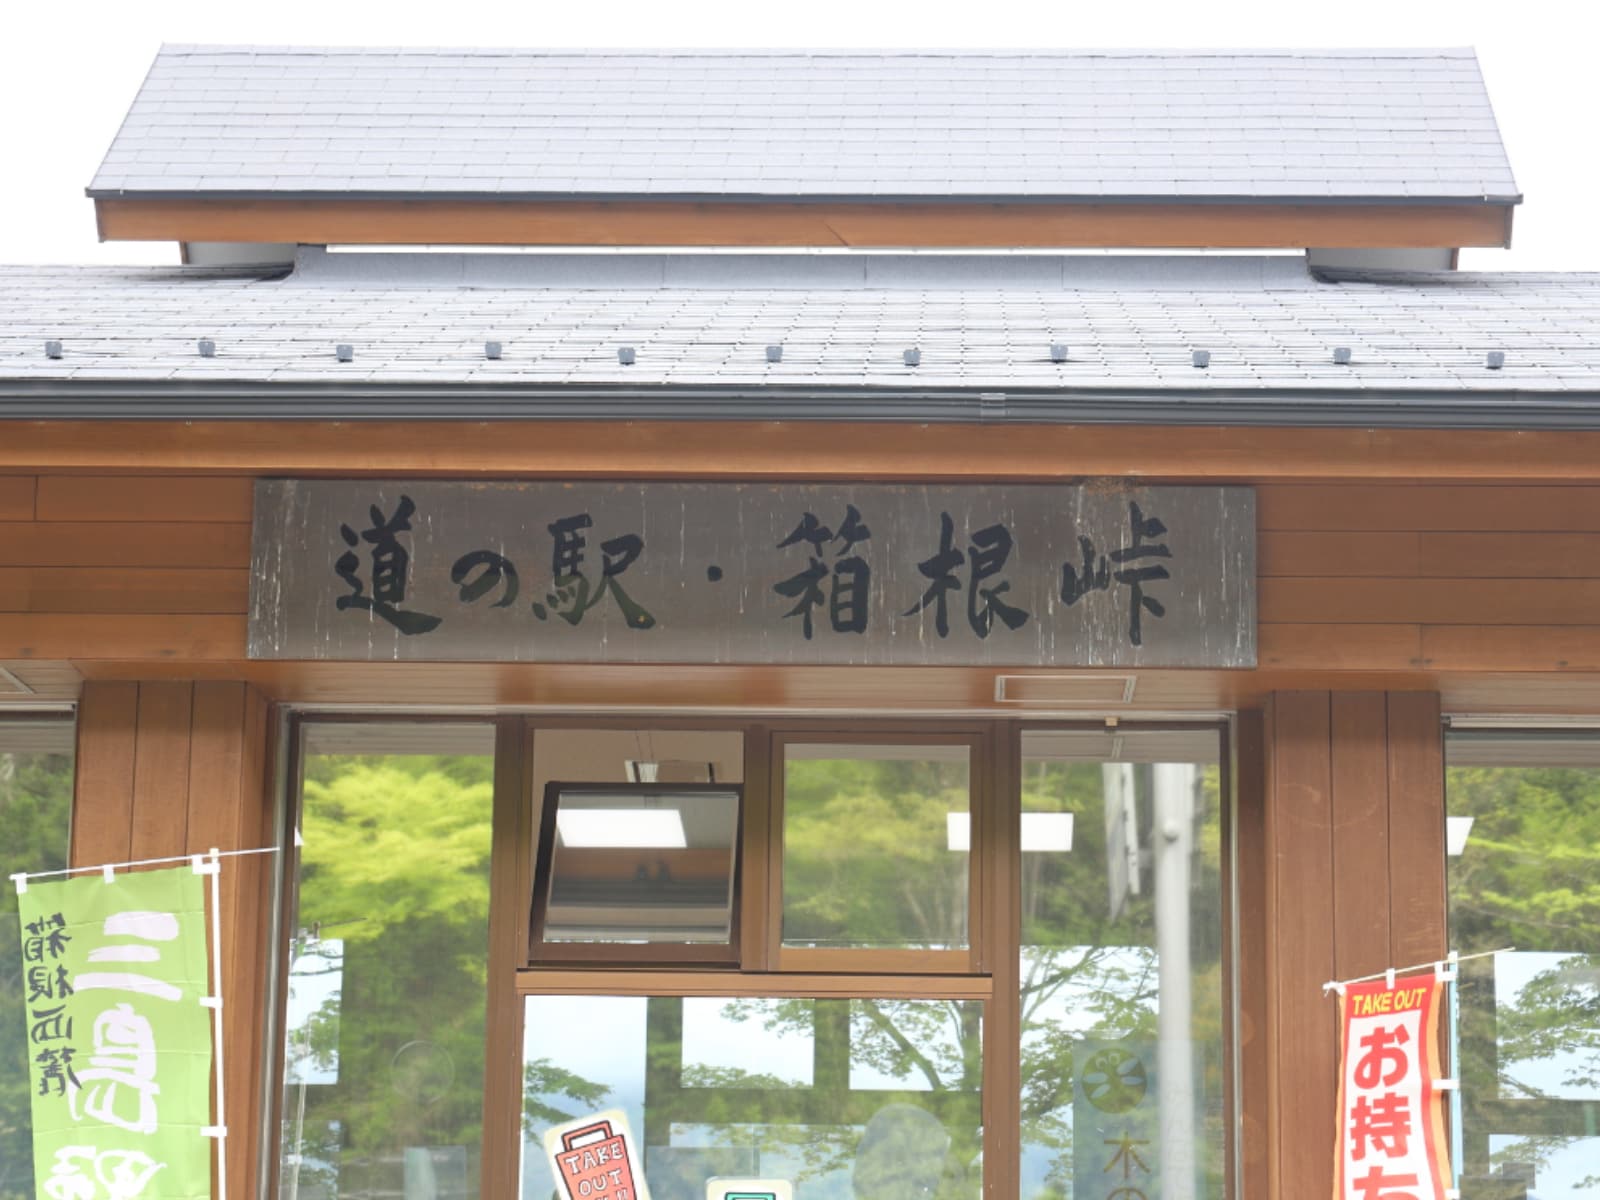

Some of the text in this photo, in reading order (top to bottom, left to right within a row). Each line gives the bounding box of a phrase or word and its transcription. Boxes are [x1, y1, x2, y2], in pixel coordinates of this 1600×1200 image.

[334, 494, 1173, 647] 道の駅・箱根峠
[1353, 987, 1427, 1016] TAKE OUT
[564, 1141, 624, 1175] TAKE
[578, 1168, 623, 1197] OUT
